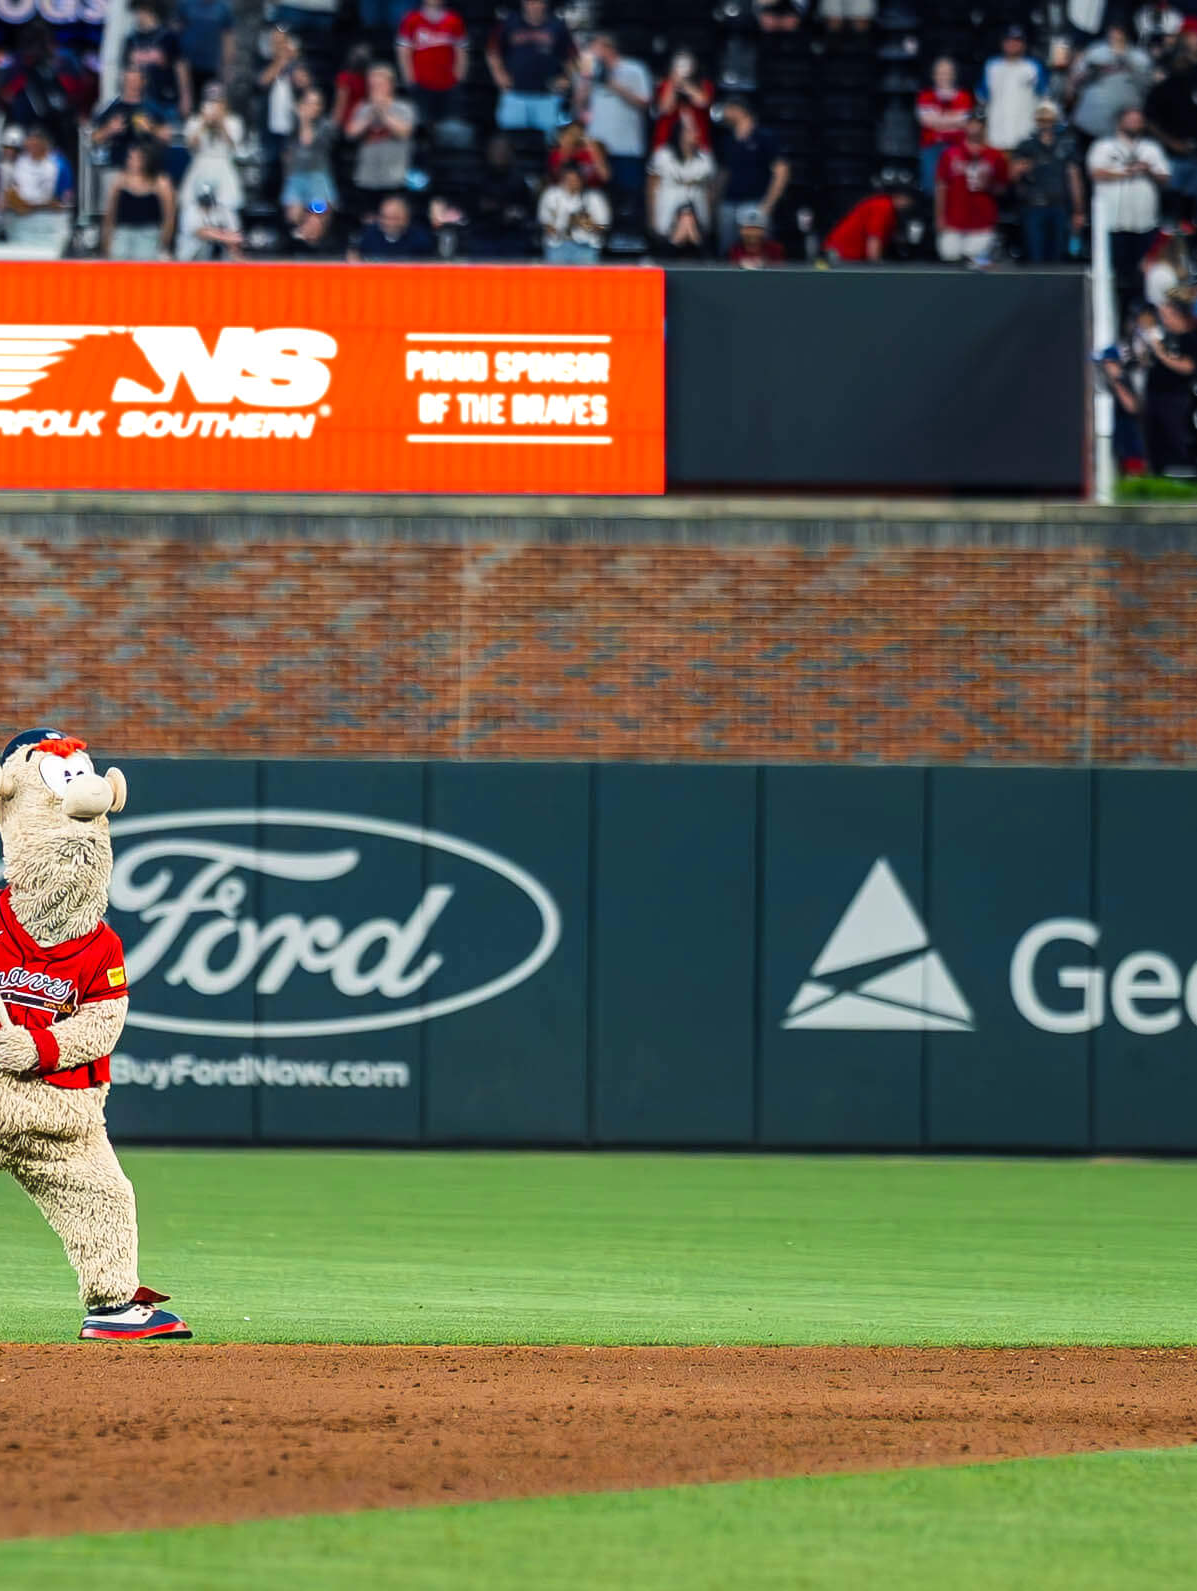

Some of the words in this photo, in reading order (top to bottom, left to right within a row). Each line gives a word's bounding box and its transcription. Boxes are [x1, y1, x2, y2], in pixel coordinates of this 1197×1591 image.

[405, 350, 488, 382] PROUD
[494, 351, 610, 383] SPONSOR
[116, 411, 316, 439] SOUTHERN
[418, 392, 451, 424] OF
[456, 393, 506, 424] THE
[511, 393, 608, 425] BRAVES
[109, 838, 454, 999] Ford
[1009, 916, 1197, 1036] Ge
[111, 1053, 410, 1091] BuyFordNow.com
